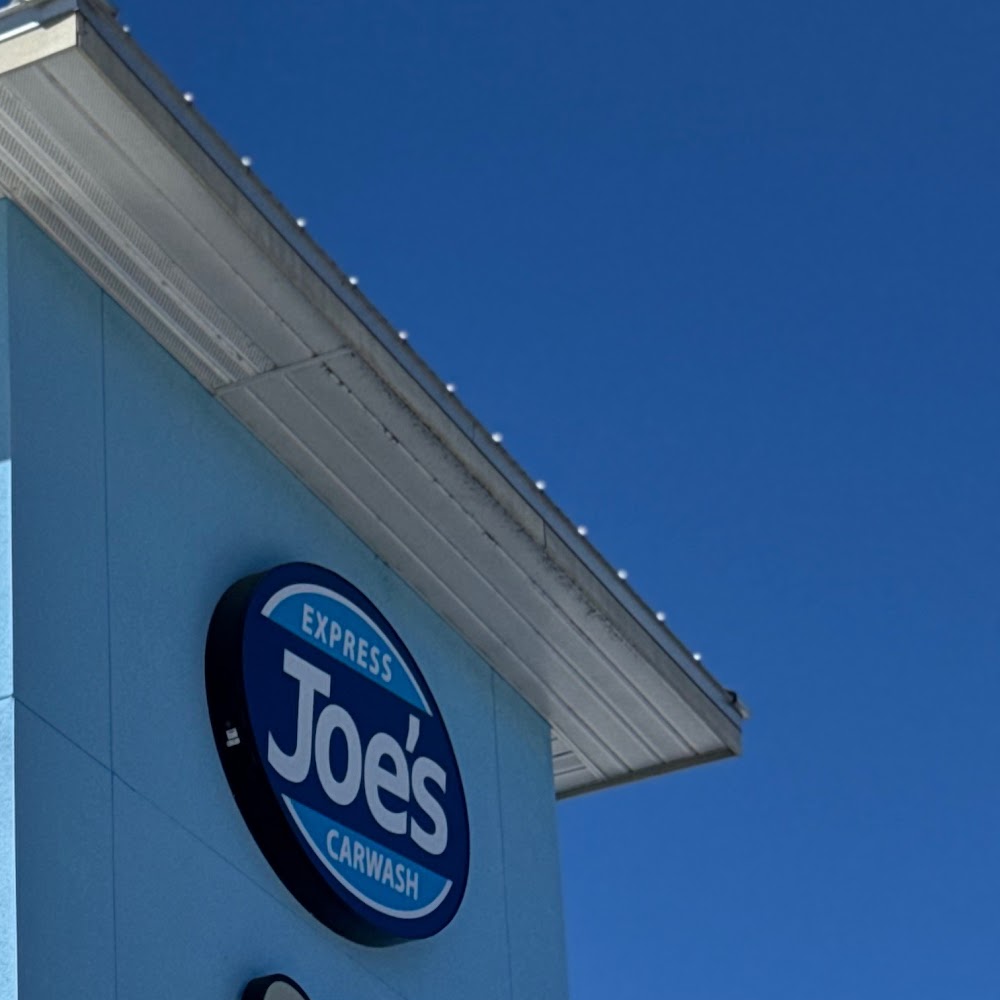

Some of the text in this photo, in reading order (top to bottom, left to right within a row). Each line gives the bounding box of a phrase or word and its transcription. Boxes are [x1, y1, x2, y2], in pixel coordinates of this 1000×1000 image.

[302, 603, 392, 683] EXPRESS
[267, 648, 448, 855] Joe's
[326, 829, 418, 900] CARWASH
